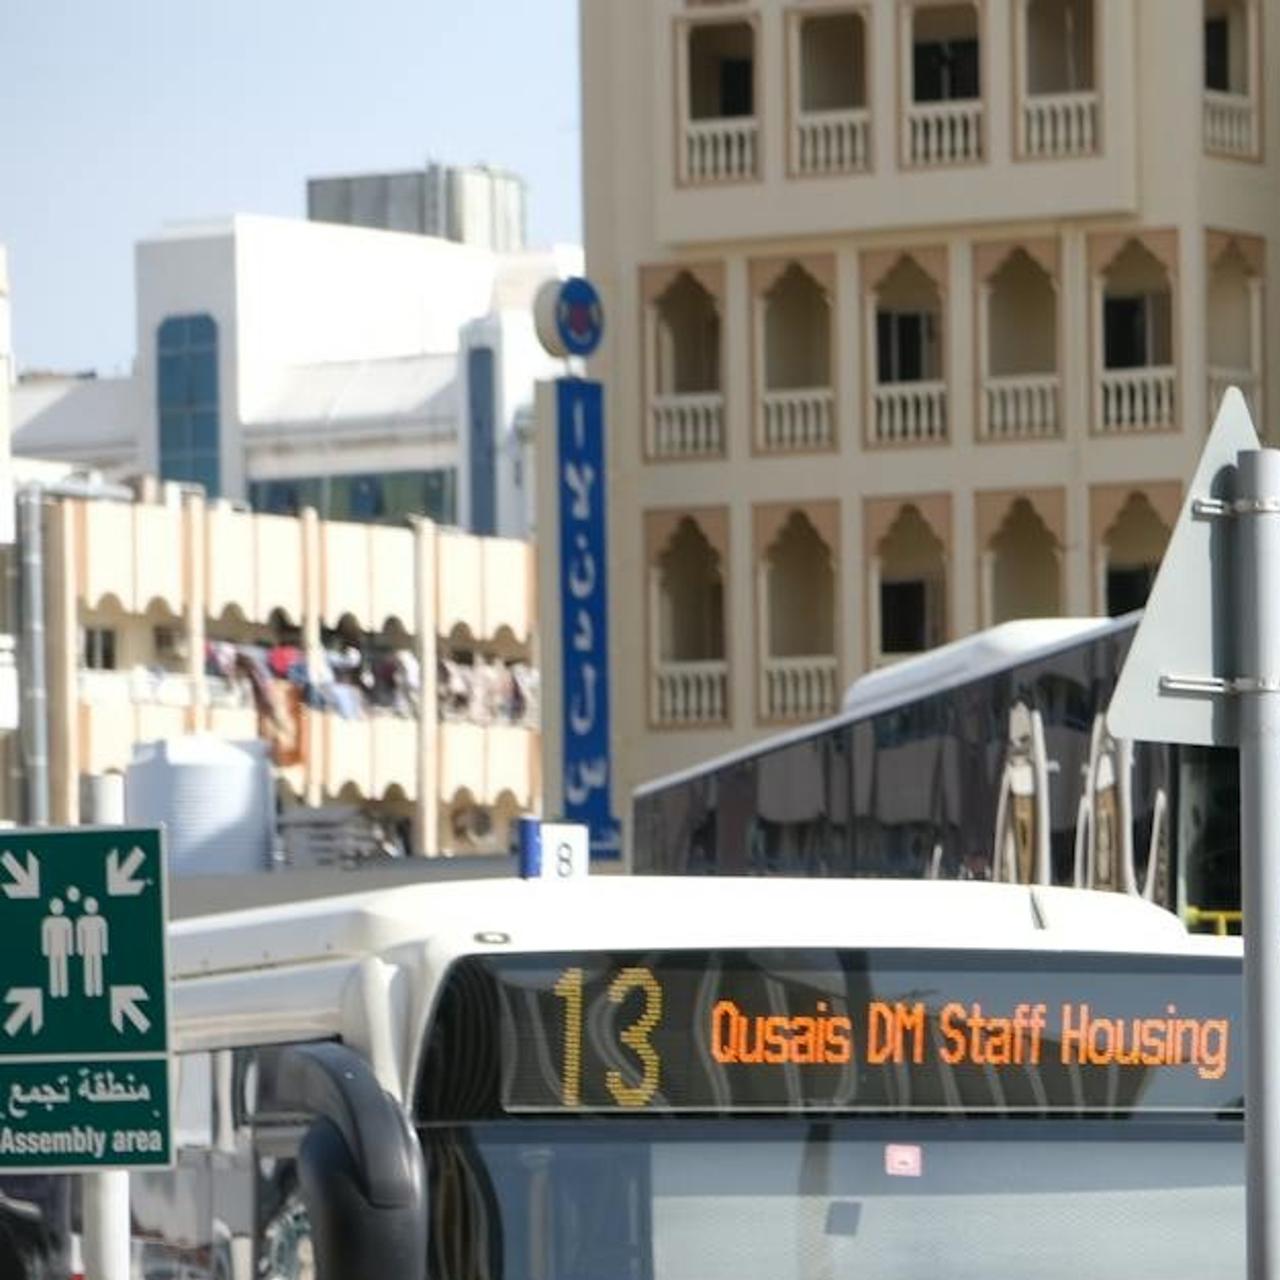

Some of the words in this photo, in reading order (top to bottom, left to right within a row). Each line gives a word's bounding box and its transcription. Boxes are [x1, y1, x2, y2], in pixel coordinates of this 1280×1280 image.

[556, 841, 573, 878] 8
[552, 966, 666, 1108] 13
[709, 1000, 853, 1065] Qusais
[866, 1000, 926, 1064] DM
[938, 1003, 1048, 1065] Staff
[1060, 1005, 1231, 1080] Housing
[7, 1074, 71, 1119] تجمع
[77, 1067, 151, 1103] منطقة
[0, 1125, 106, 1160] Assembly
[112, 1129, 163, 1152] area
